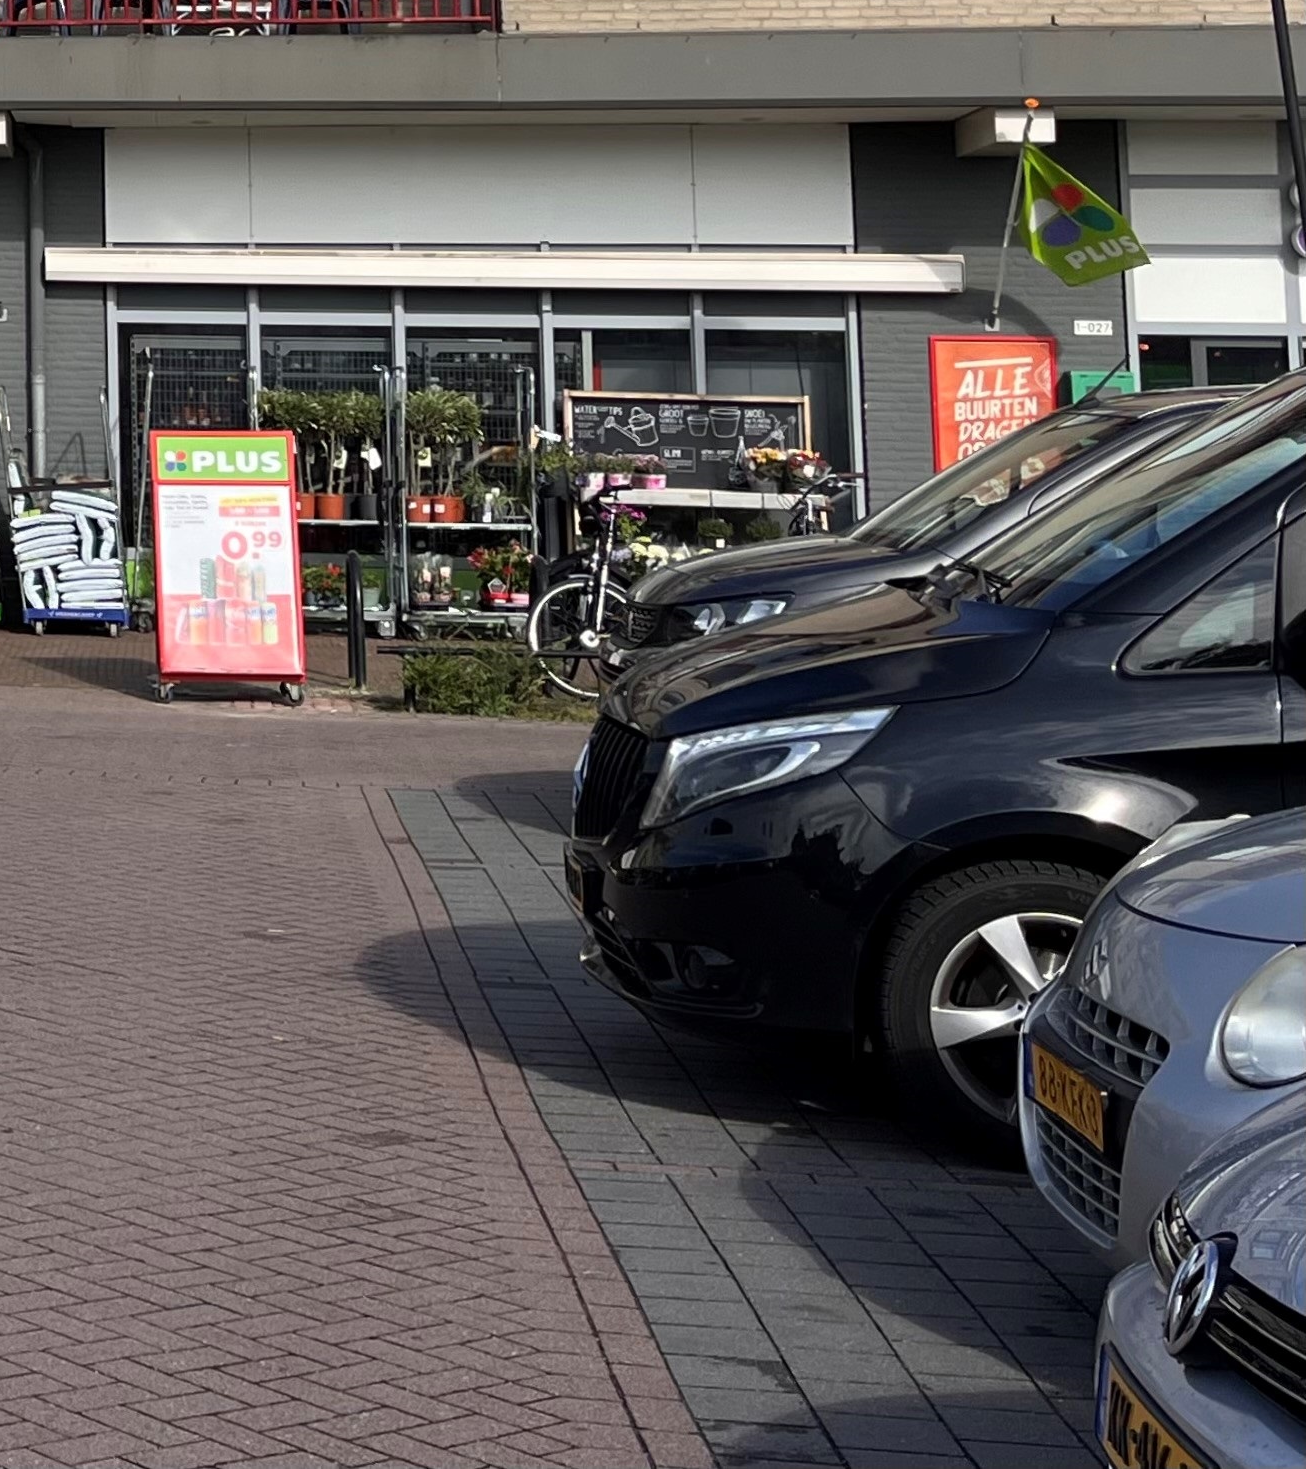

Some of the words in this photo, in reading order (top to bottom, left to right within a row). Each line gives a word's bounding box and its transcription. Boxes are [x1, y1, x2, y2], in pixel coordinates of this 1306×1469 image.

[1064, 235, 1140, 270] PLUS
[1075, 322, 1110, 334] 1-027
[956, 365, 1033, 399] ALLE
[953, 396, 1038, 422] BUURTEN
[191, 450, 283, 474] PLUS
